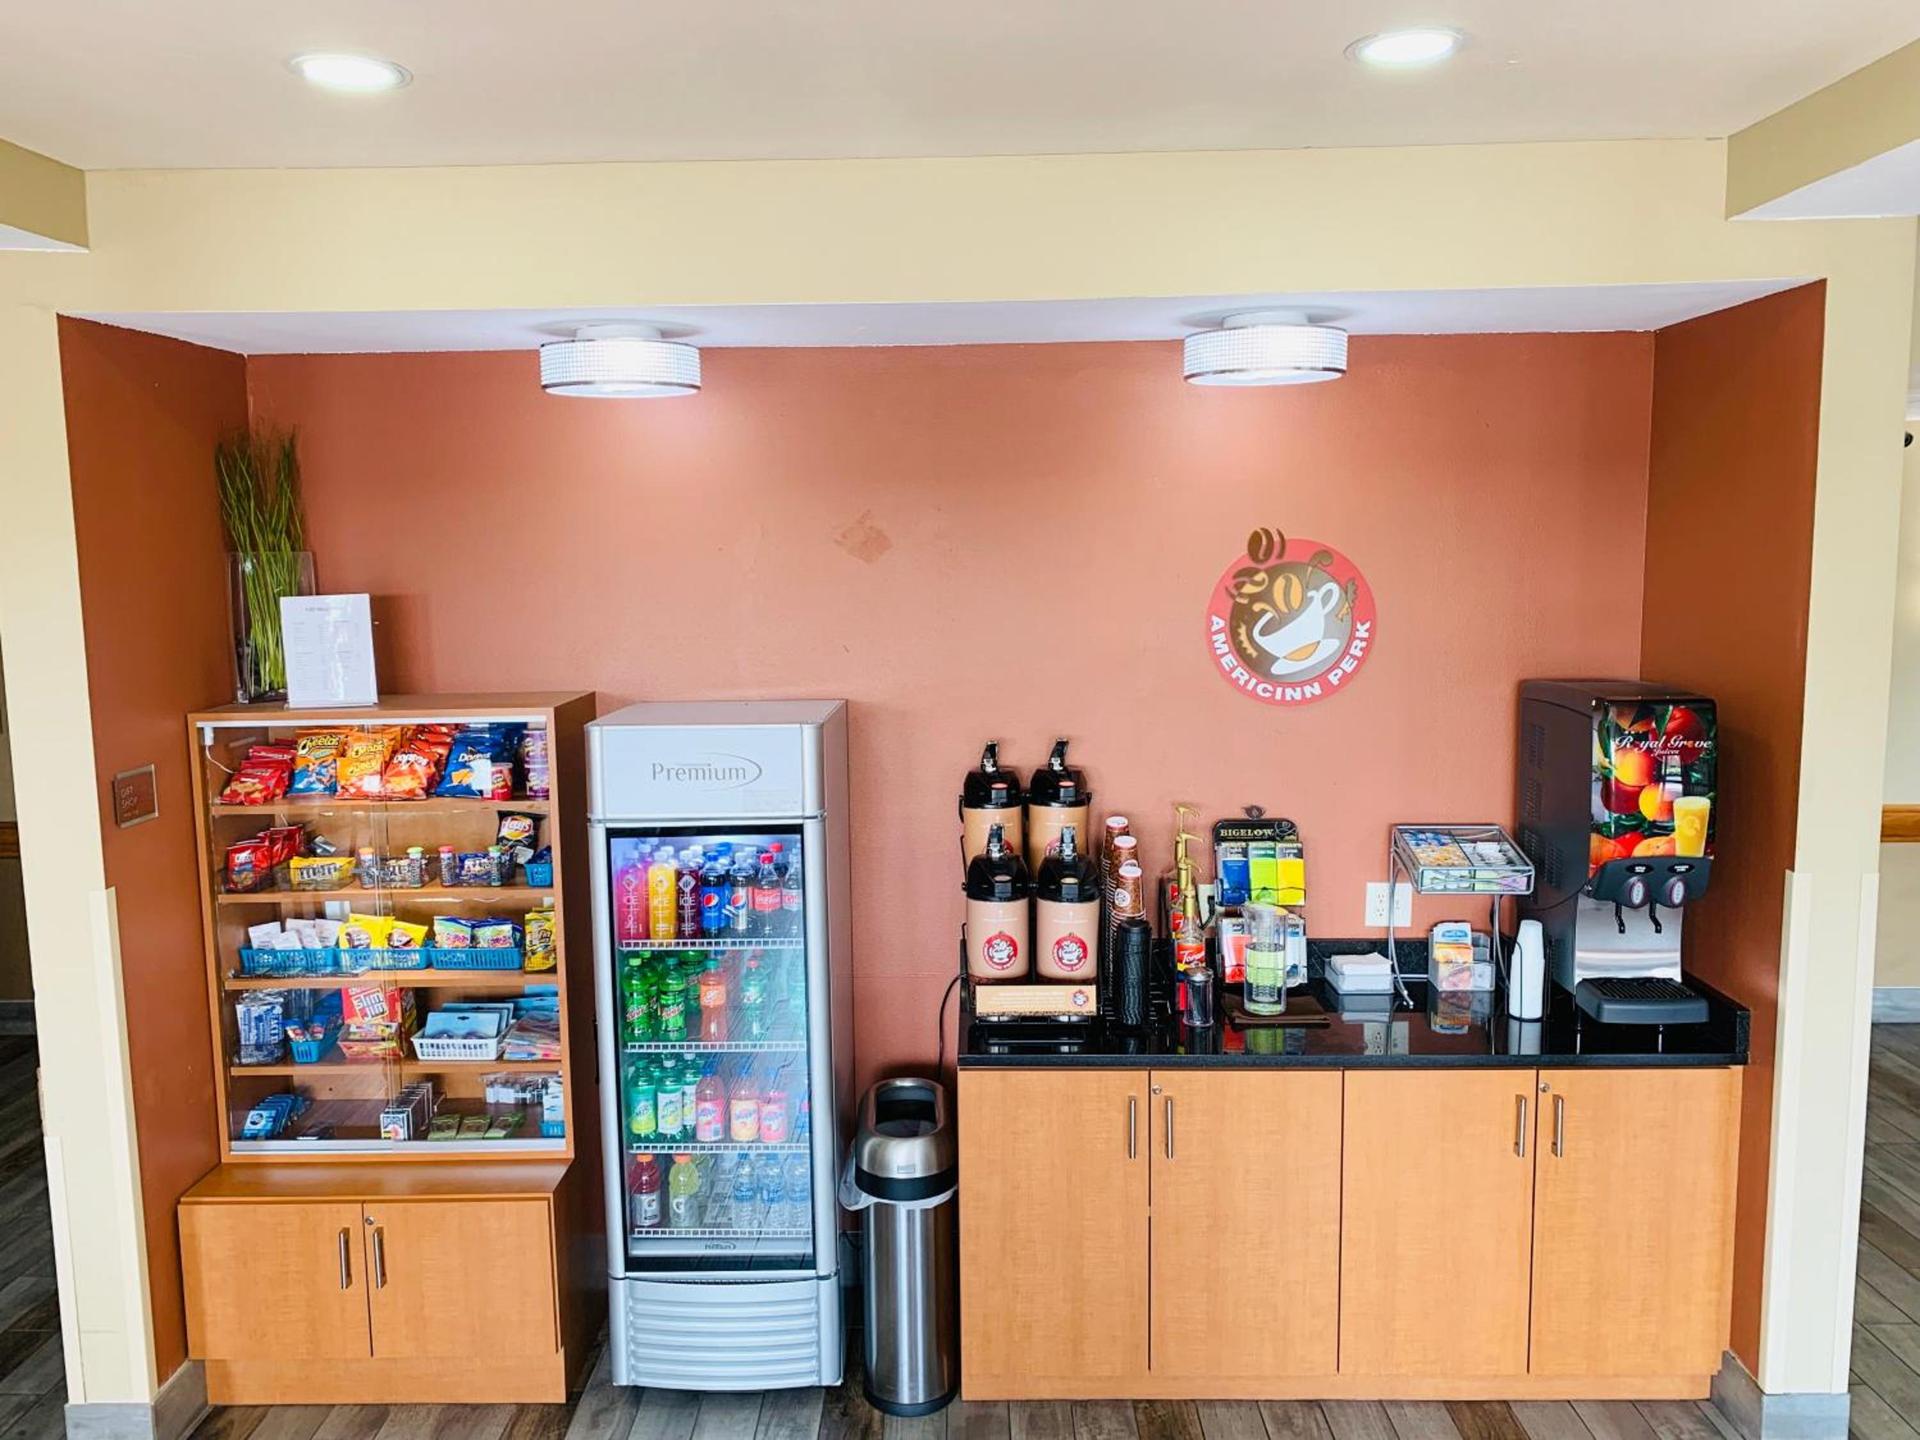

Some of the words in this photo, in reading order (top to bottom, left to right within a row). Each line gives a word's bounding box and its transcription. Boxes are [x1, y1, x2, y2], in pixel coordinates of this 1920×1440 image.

[1210, 614, 1323, 701] AMERICINN
[1327, 620, 1372, 686] PERK
[1615, 734, 1667, 753] Royal
[1667, 734, 1713, 749] Grove
[651, 762, 747, 781] Premium
[1220, 828, 1275, 837] BIGELOW
